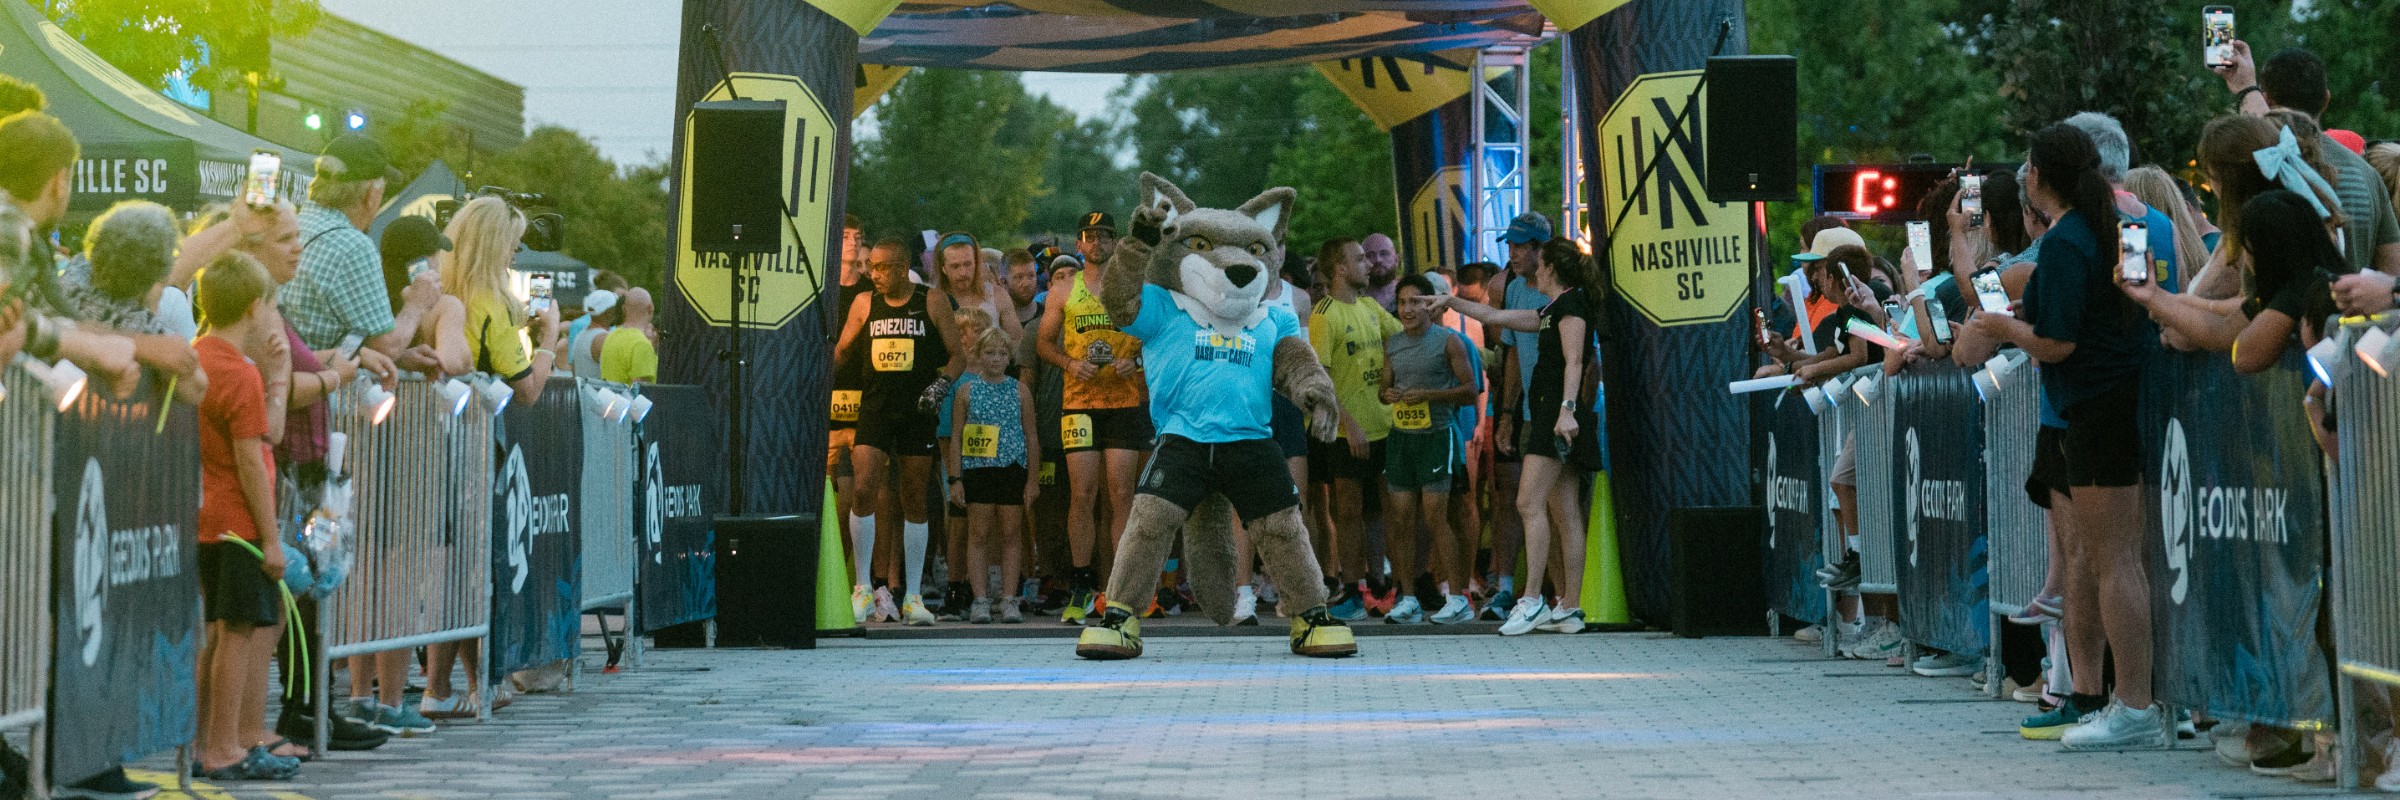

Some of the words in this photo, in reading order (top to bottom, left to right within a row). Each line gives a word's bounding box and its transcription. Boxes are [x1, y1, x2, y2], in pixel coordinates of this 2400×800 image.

[134, 158, 167, 193] SC
[694, 246, 804, 274] NASVILLE
[1631, 235, 1741, 272] NASHVILLE
[557, 271, 577, 289] SC
[1676, 271, 1705, 300] SC
[870, 318, 926, 337] VENEZUELA
[1076, 314, 1113, 330] RUNNE
[878, 351, 907, 361] 0671
[1195, 345, 1214, 361] DASH
[833, 403, 860, 413] 0415
[1396, 410, 1426, 420] 0535
[967, 437, 992, 447] 0617
[2198, 486, 2248, 540] EODIS
